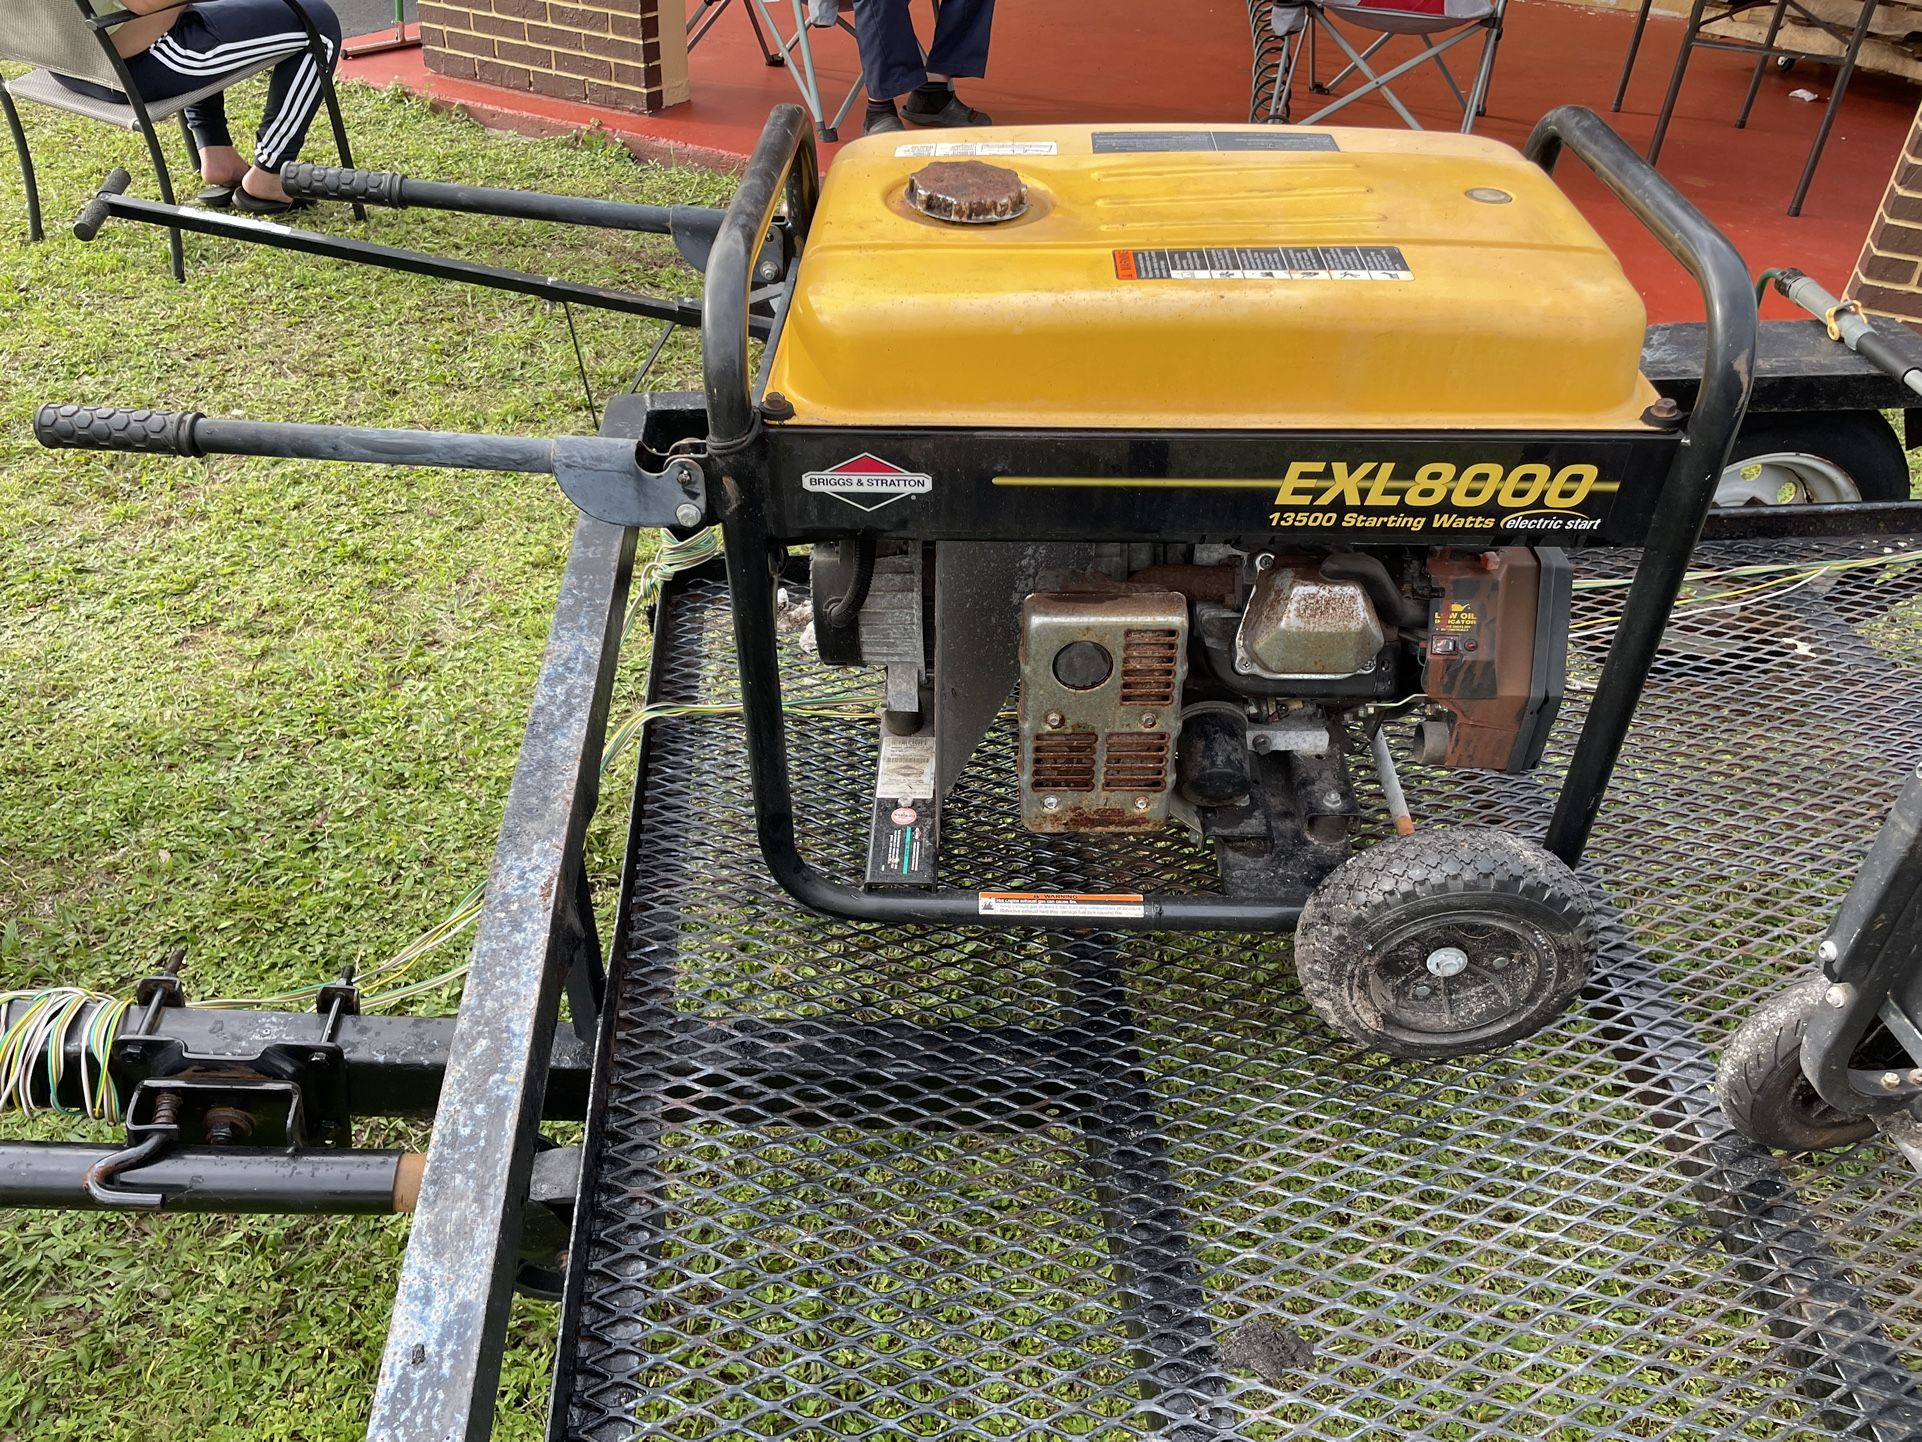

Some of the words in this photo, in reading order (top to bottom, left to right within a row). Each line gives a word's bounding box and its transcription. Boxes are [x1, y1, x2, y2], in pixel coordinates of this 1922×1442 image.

[809, 477, 853, 487] BRIGGS
[856, 478, 864, 488] &
[867, 478, 925, 488] STRATTON
[1274, 461, 1599, 508] EXL8000
[1269, 512, 1337, 528] 13500
[1341, 513, 1426, 531] Starting
[1432, 514, 1495, 529] Watts
[1506, 516, 1564, 530] electric
[1565, 518, 1602, 531] start
